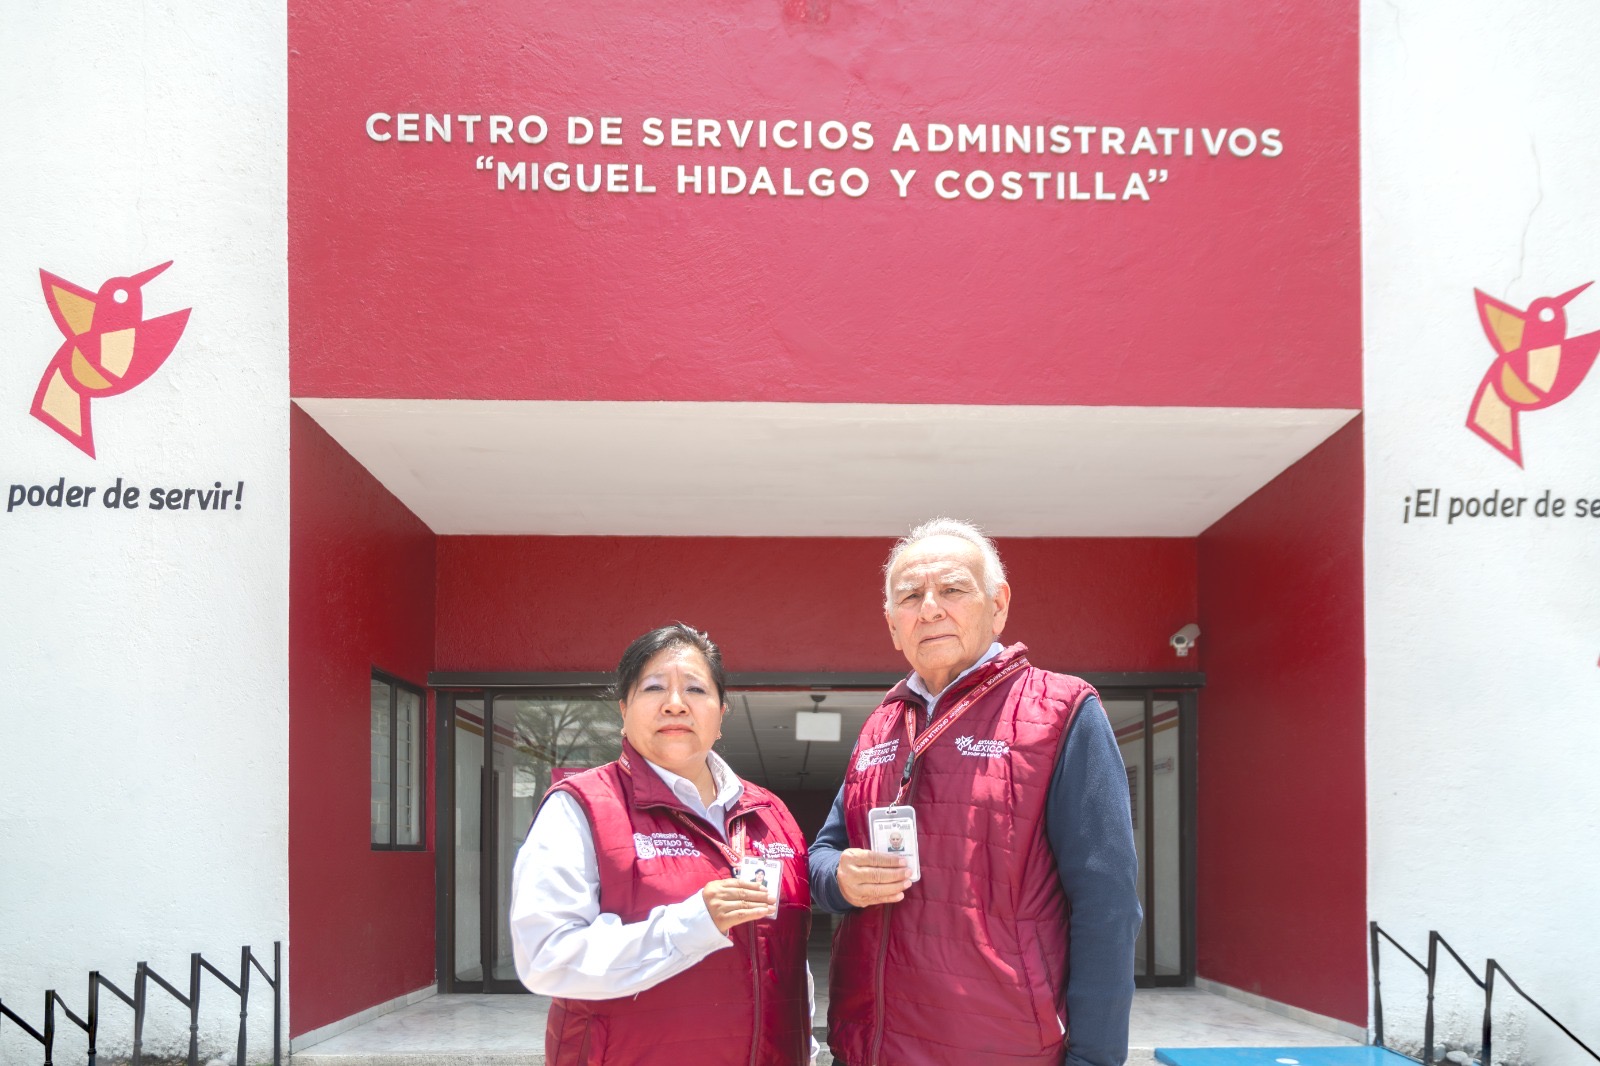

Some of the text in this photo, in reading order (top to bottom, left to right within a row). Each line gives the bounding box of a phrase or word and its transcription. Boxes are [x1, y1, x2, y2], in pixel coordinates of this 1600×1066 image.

[365, 111, 1285, 158] CENTRO DE SERVICIOS ADMINISTRATIVOS
[475, 155, 1169, 201] “MIGUEL HIDALGO Y COSTILLA”
[6, 476, 245, 513] poder de servir!
[1403, 488, 1440, 524] ¡El
[1447, 489, 1528, 525] poder
[1534, 489, 1566, 518] de
[653, 839, 695, 849] ESTADO DE
[655, 846, 701, 858] MÉXICO
